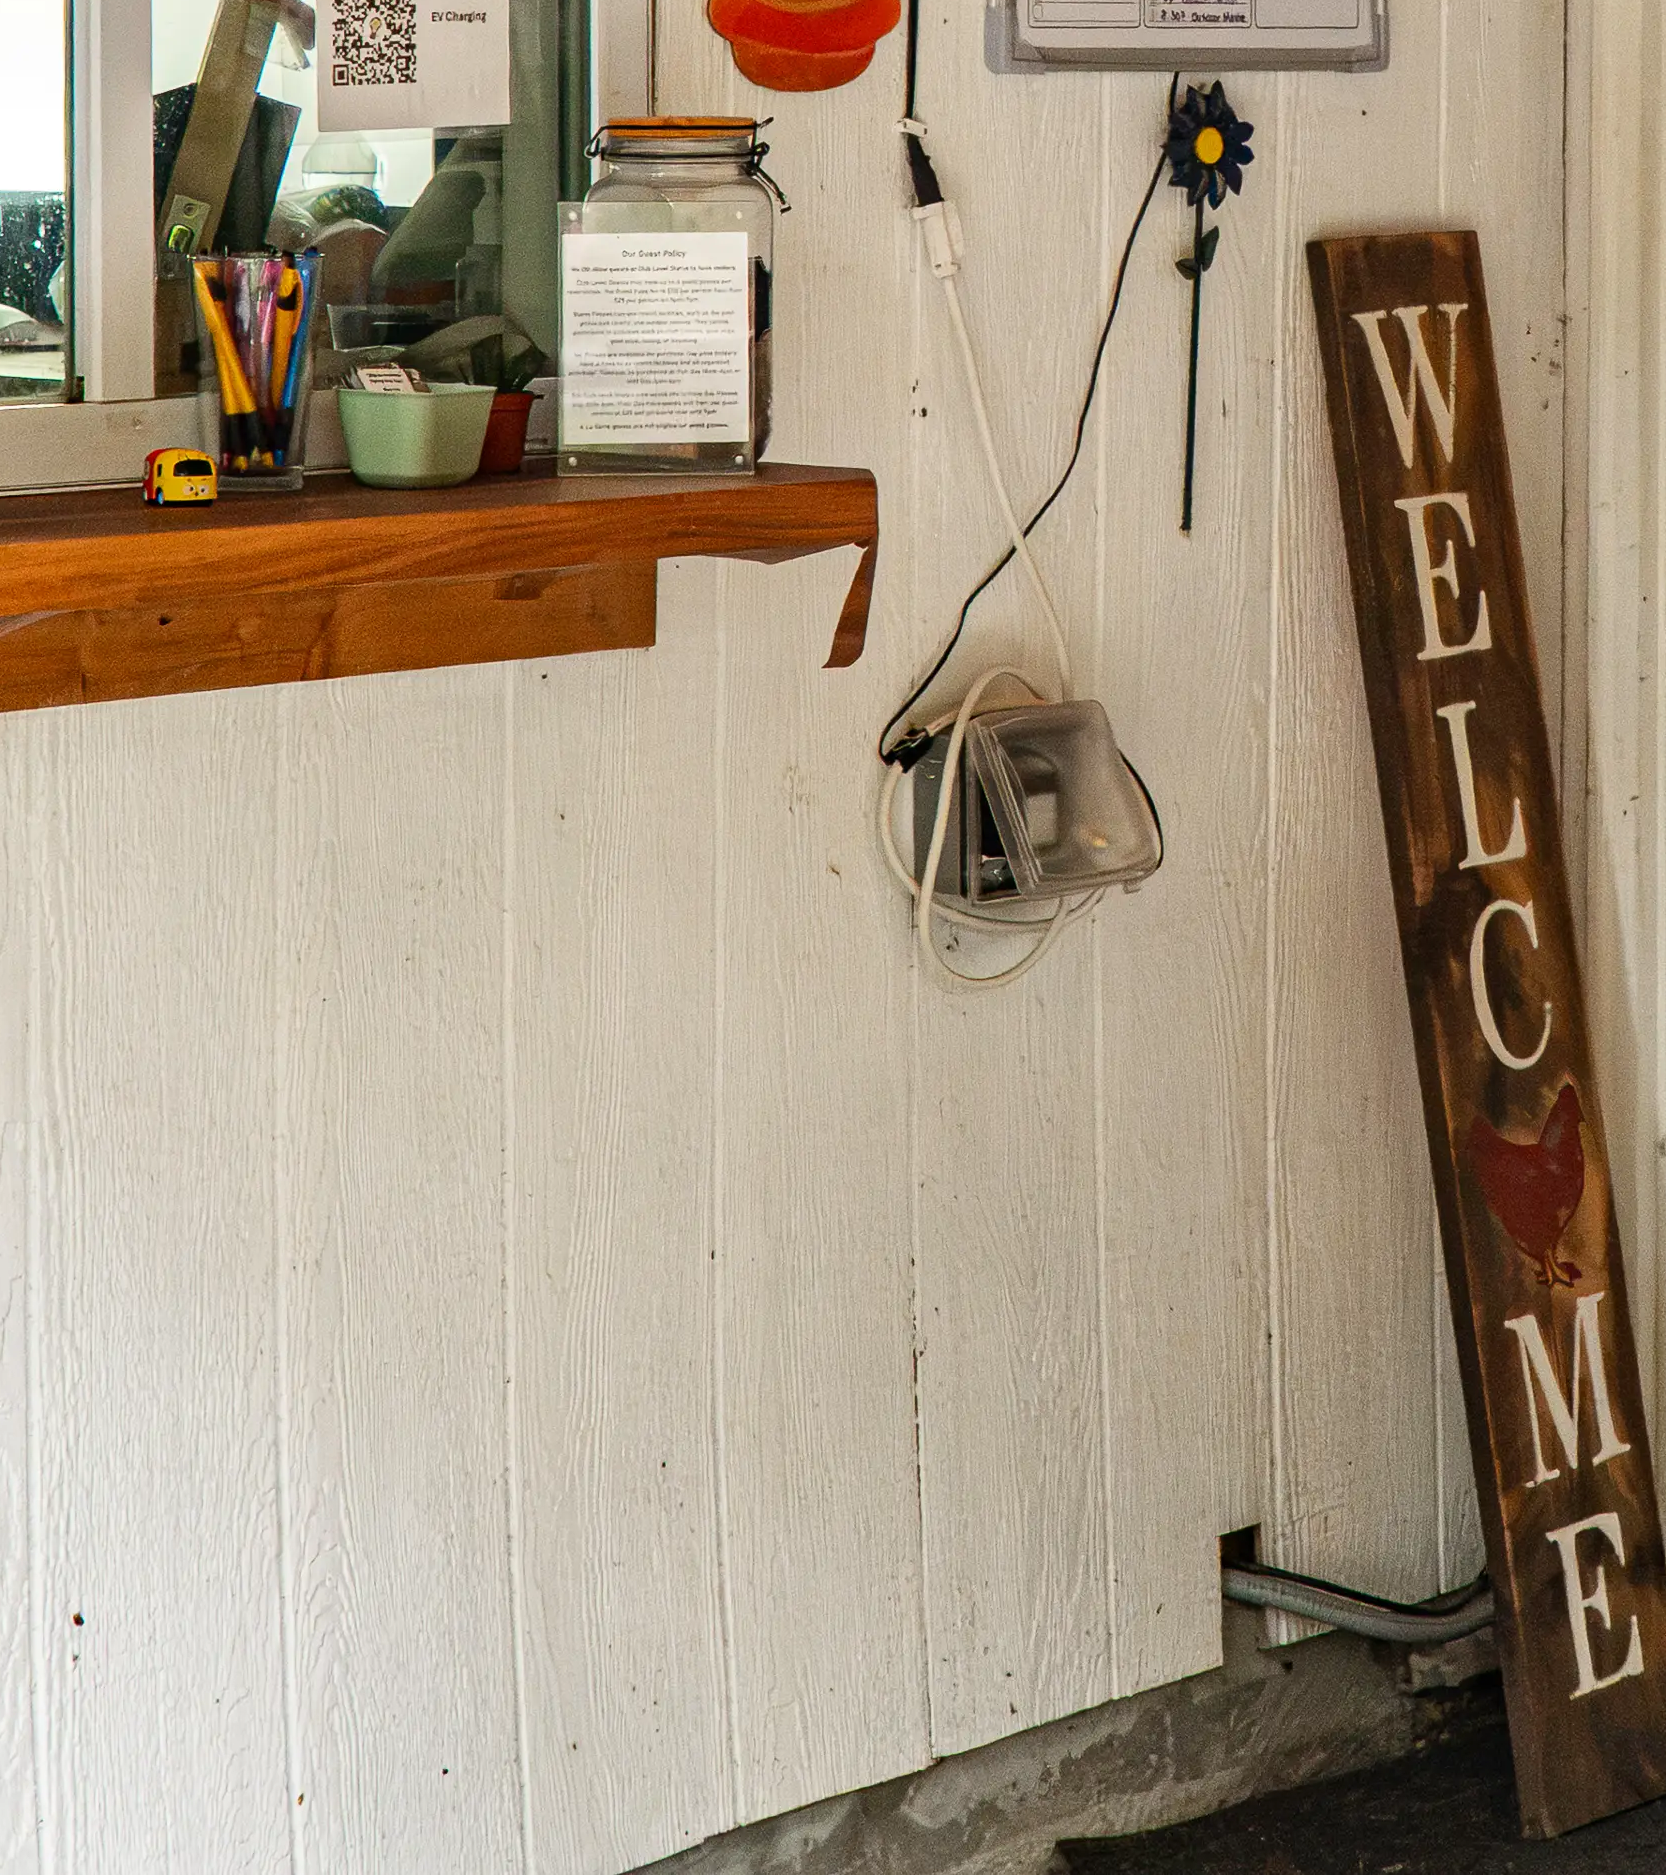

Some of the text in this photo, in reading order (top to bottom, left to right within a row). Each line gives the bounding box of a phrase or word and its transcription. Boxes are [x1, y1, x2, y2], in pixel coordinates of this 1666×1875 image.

[431, 11, 487, 23] EV Charging
[622, 250, 687, 259] Our Guest Policy
[1351, 303, 1644, 1700] WELCME
